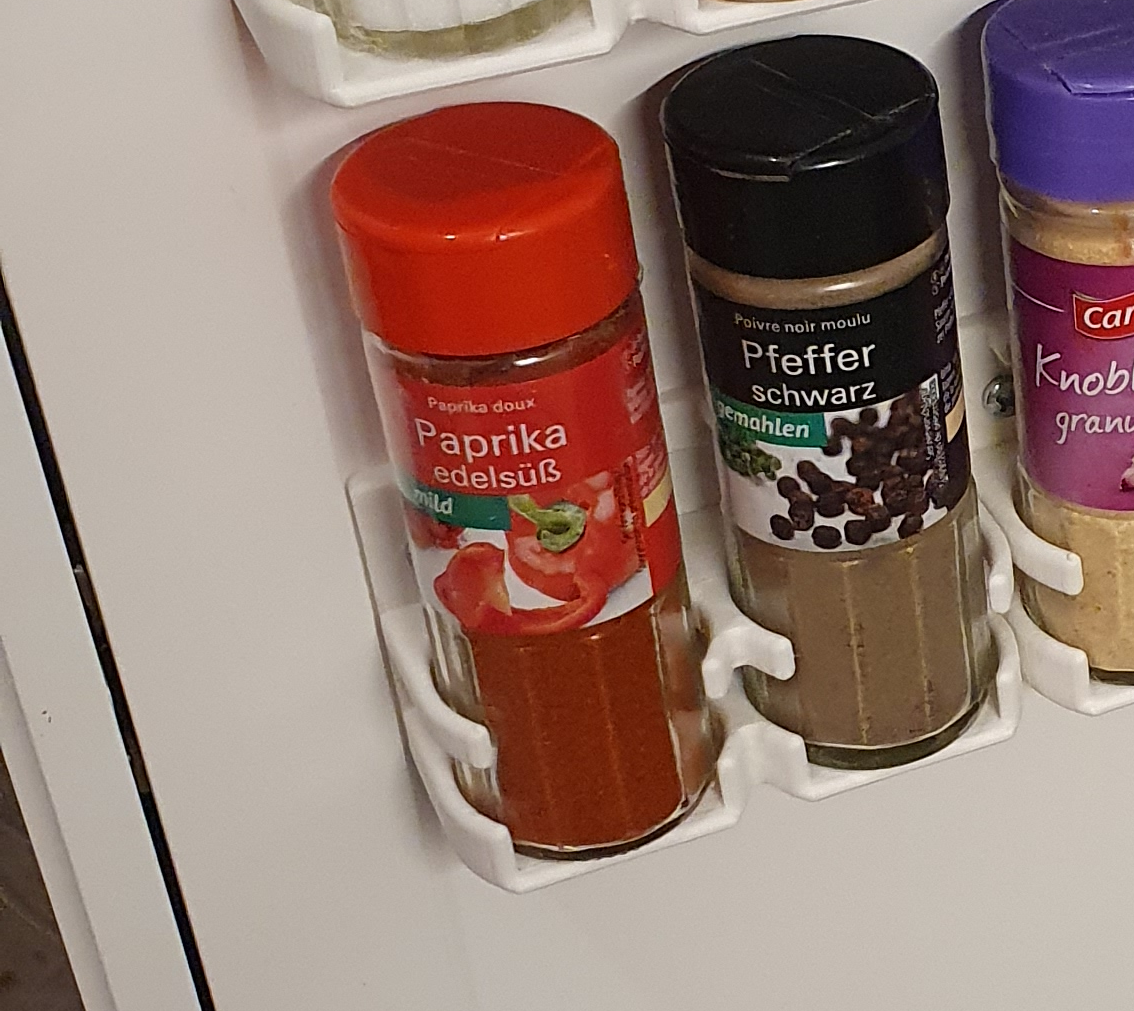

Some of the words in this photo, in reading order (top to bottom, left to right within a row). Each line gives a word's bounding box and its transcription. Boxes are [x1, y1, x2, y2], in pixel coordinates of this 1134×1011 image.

[734, 312, 781, 333] Poivre
[783, 320, 817, 334] noir
[820, 312, 871, 332] moulu
[741, 339, 876, 376] Pfeffer
[427, 396, 488, 414] Paprika
[492, 396, 536, 413] doux
[751, 380, 878, 408] schwarz
[717, 400, 810, 439] gemahlen
[414, 417, 568, 463] Paprika
[433, 457, 562, 490] edelsüß
